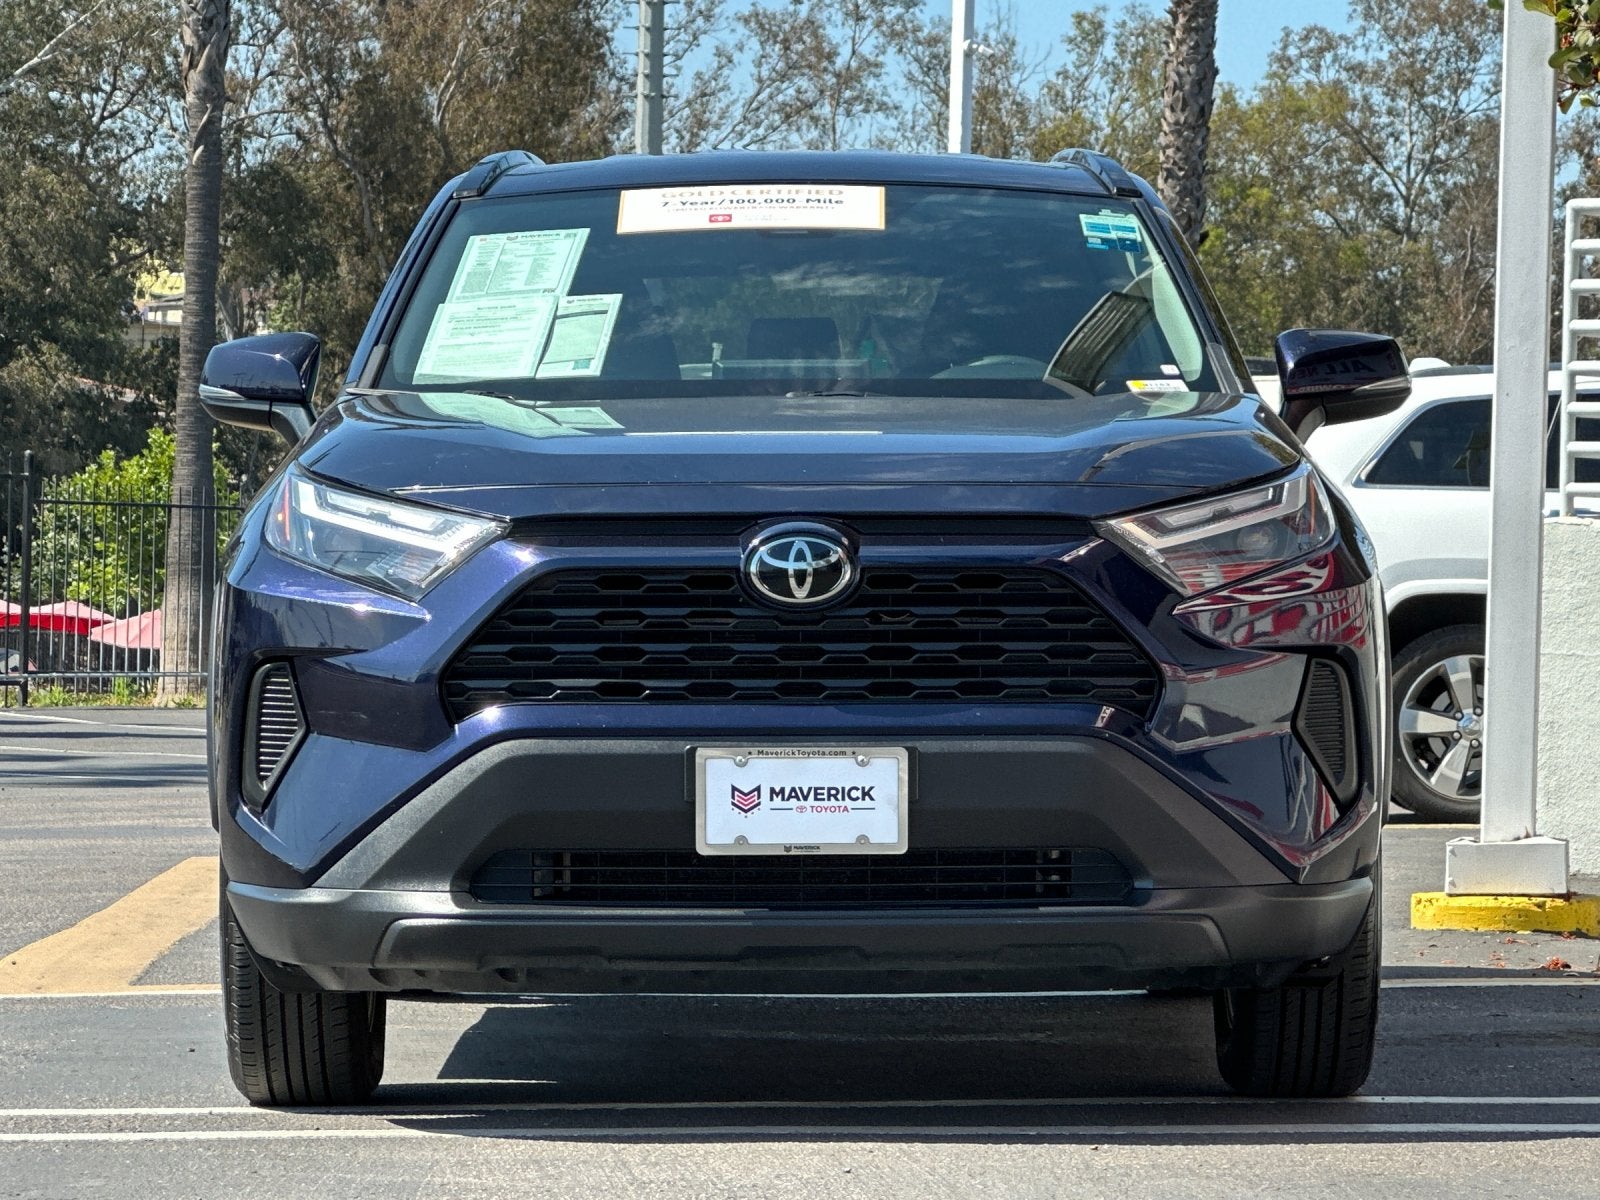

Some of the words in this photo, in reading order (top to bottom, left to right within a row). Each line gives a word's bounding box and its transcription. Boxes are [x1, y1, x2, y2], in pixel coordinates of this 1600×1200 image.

[661, 190, 725, 199] GOLD
[731, 188, 845, 196] CERTIFIED
[757, 749, 847, 757] MaverickToyota.com
[769, 785, 876, 802] MAVERICK
[809, 805, 850, 814] TOYOTA
